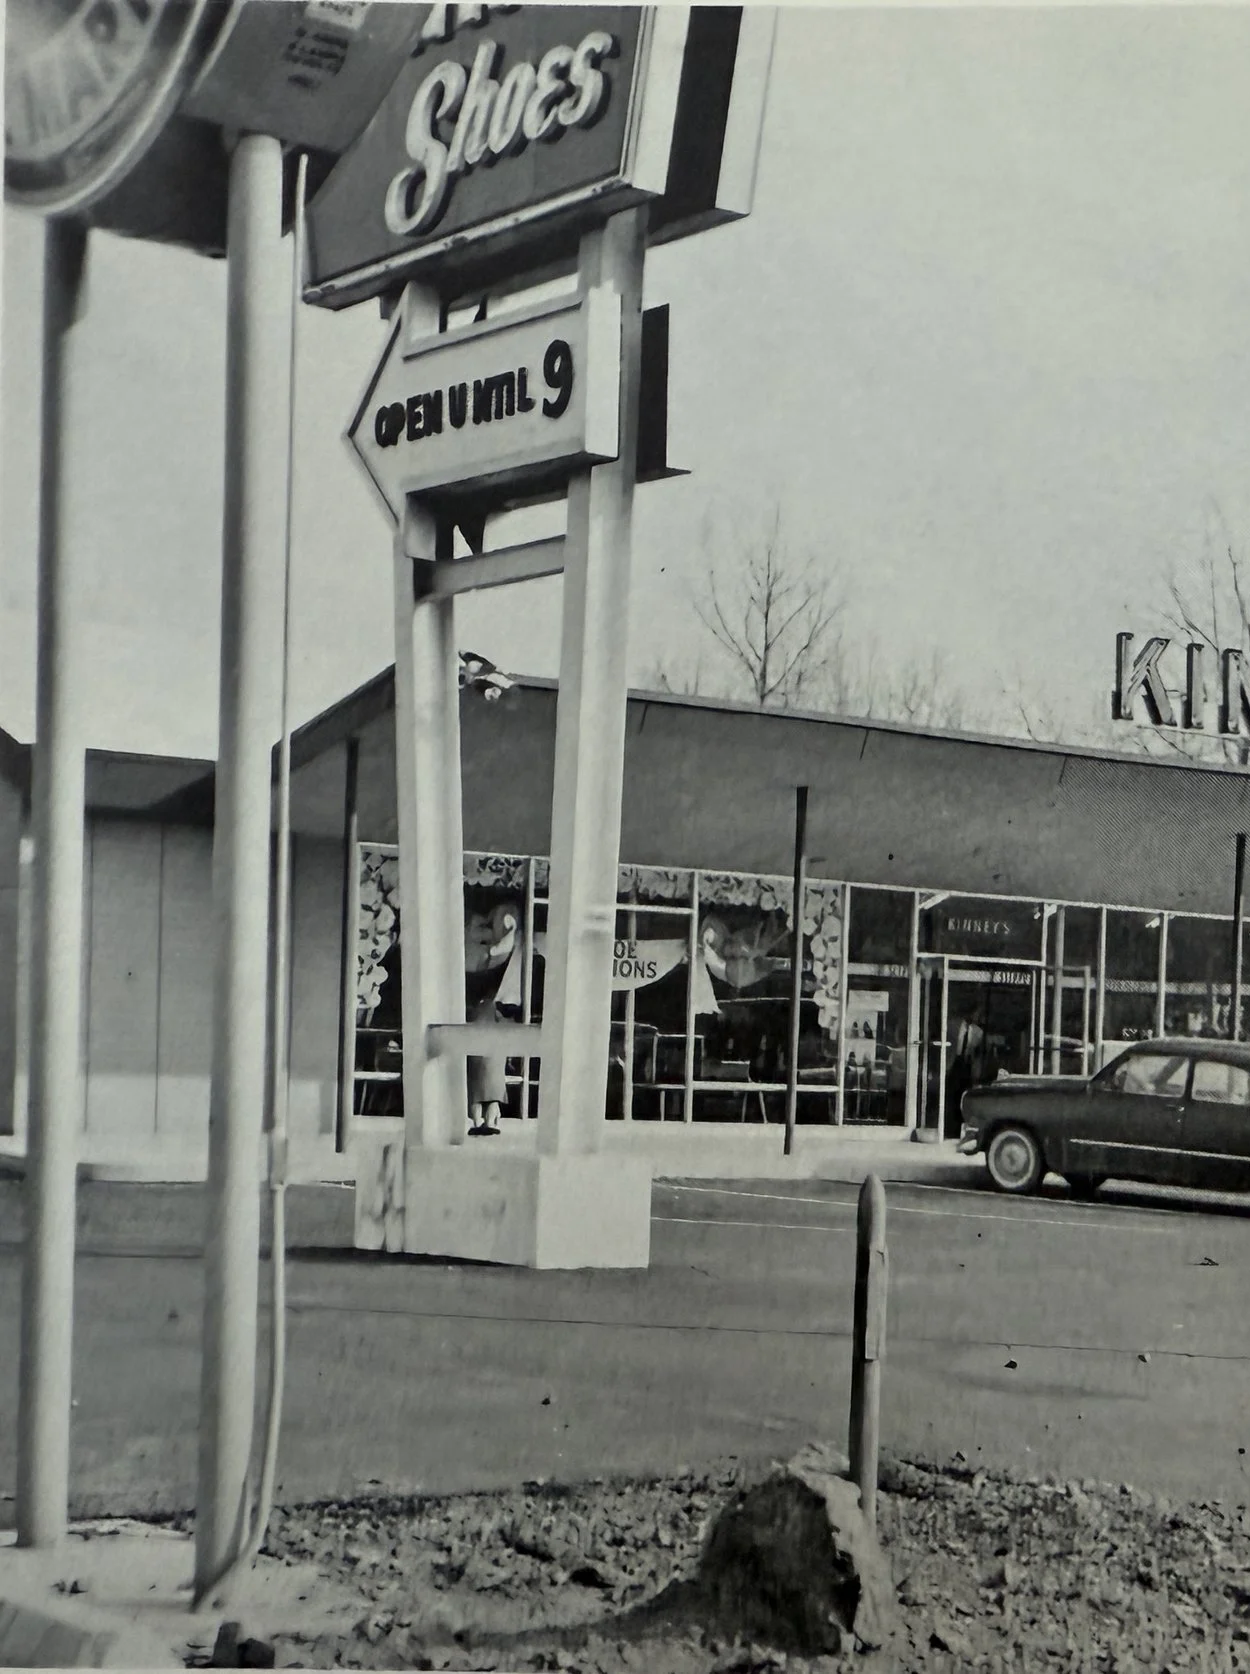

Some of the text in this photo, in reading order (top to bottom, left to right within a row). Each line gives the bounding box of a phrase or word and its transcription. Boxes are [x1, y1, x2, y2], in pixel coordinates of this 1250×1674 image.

[384, 31, 620, 237] Shoes
[374, 339, 574, 448] OPEN UNTIL 9
[612, 958, 658, 979] IONS
